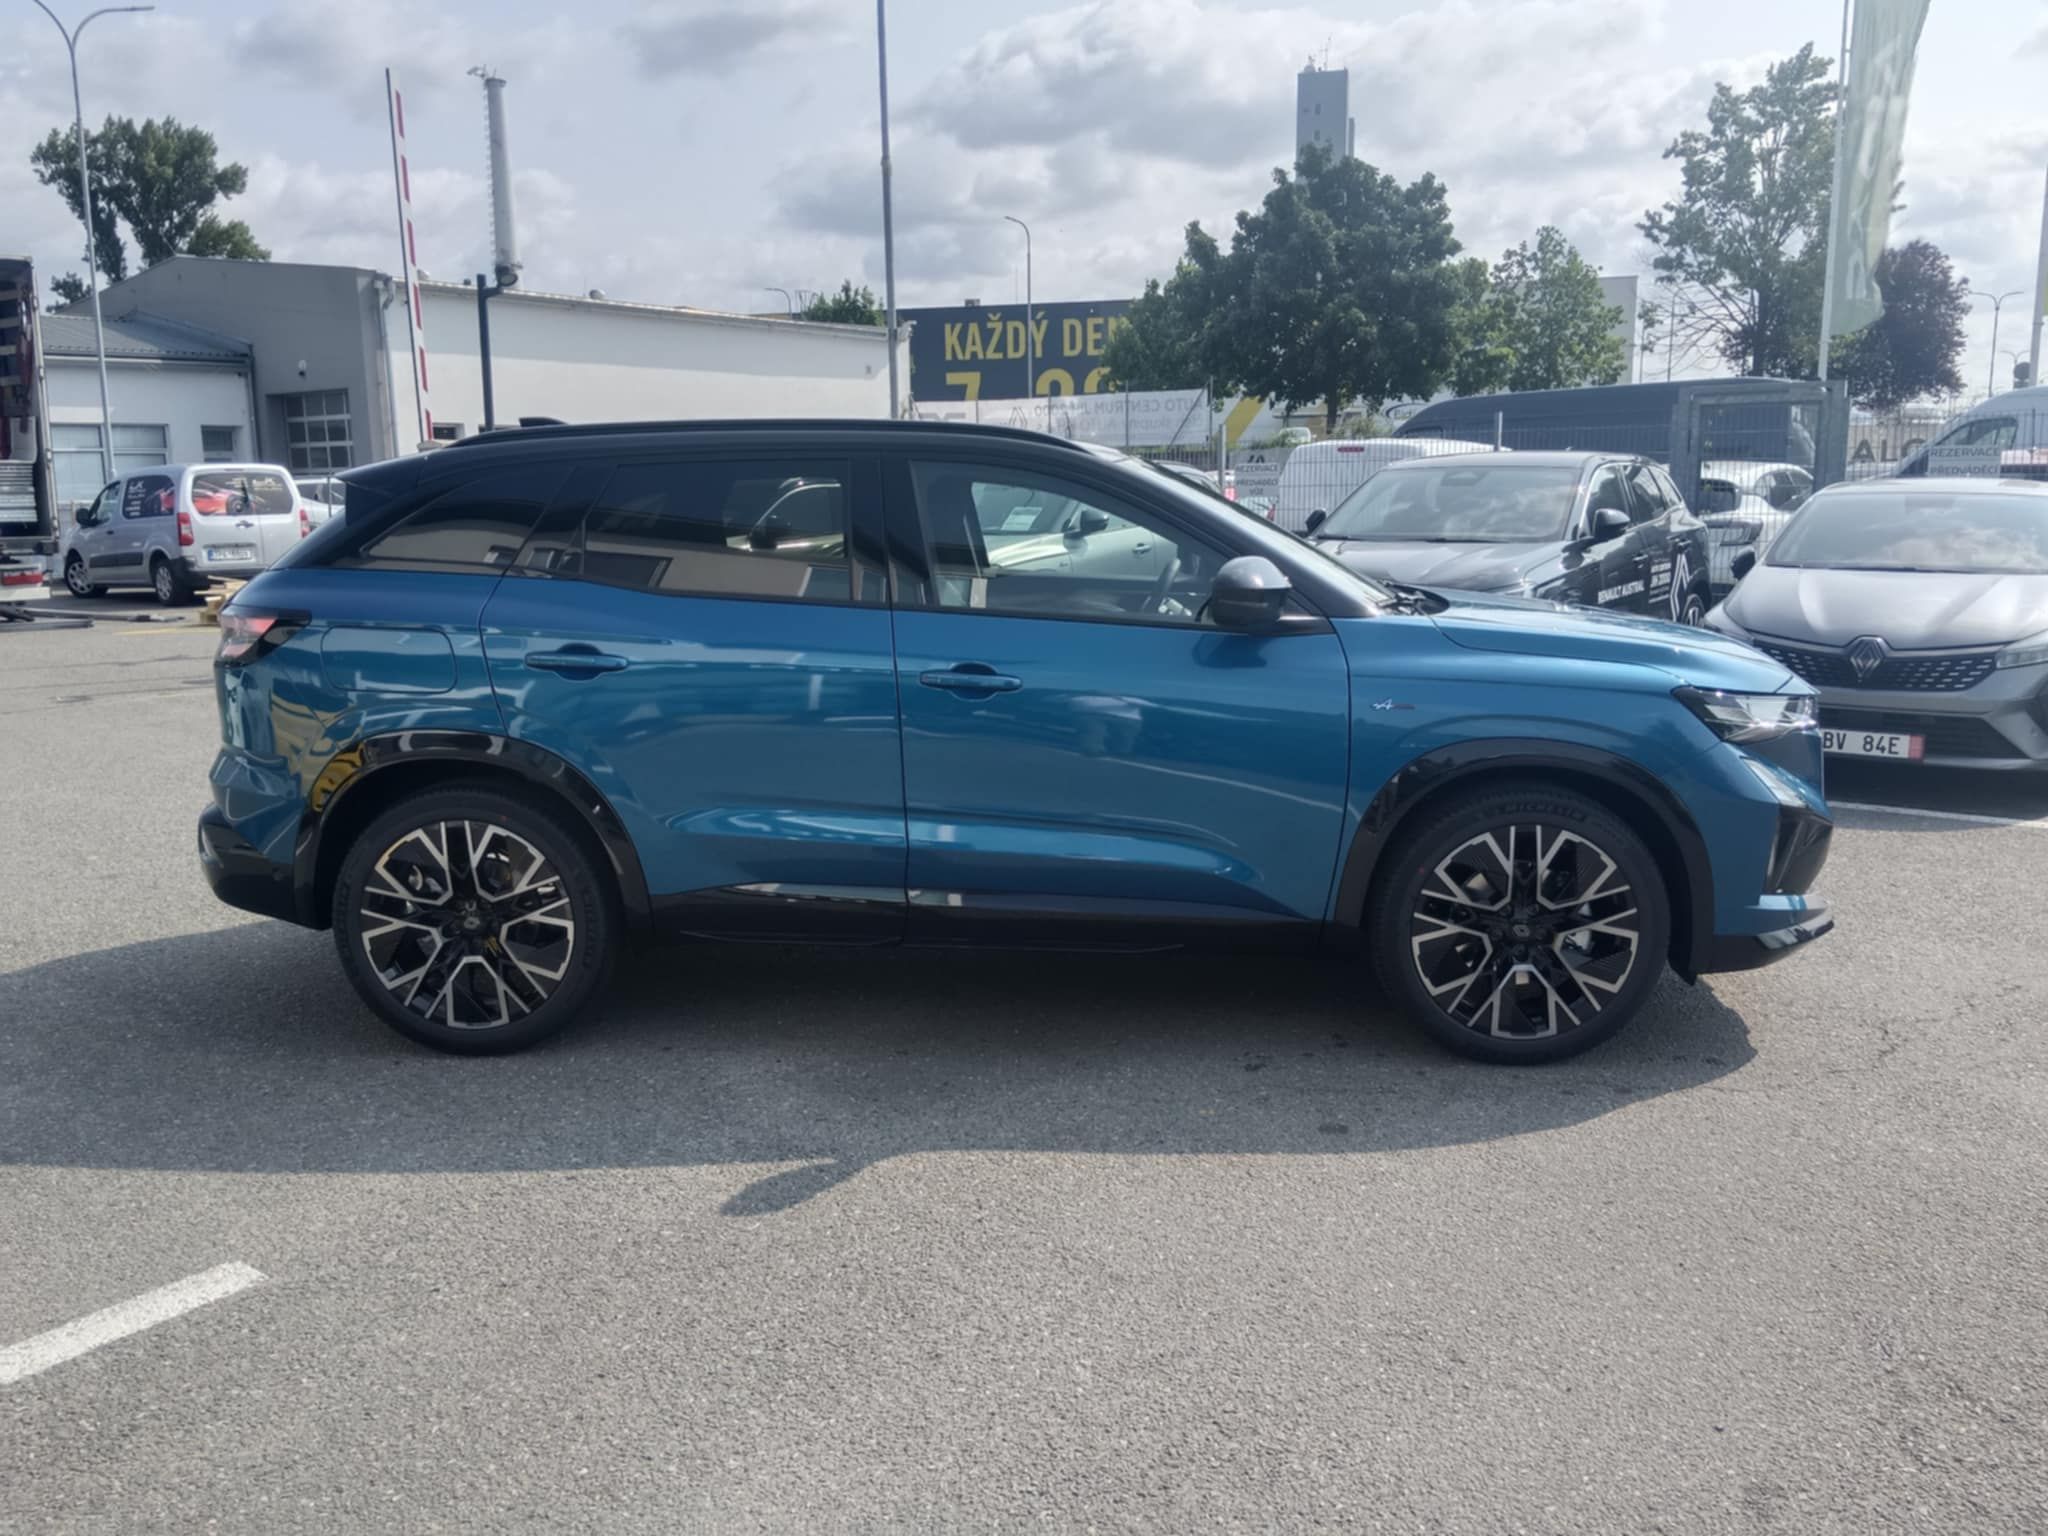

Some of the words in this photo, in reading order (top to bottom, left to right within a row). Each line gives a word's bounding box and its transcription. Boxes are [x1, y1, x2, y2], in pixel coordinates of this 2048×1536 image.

[944, 311, 1049, 361] KAŽDÝ
[1930, 446, 2000, 458] REZERVACE
[1823, 731, 1847, 750] BV
[1862, 734, 1901, 755] 84E
